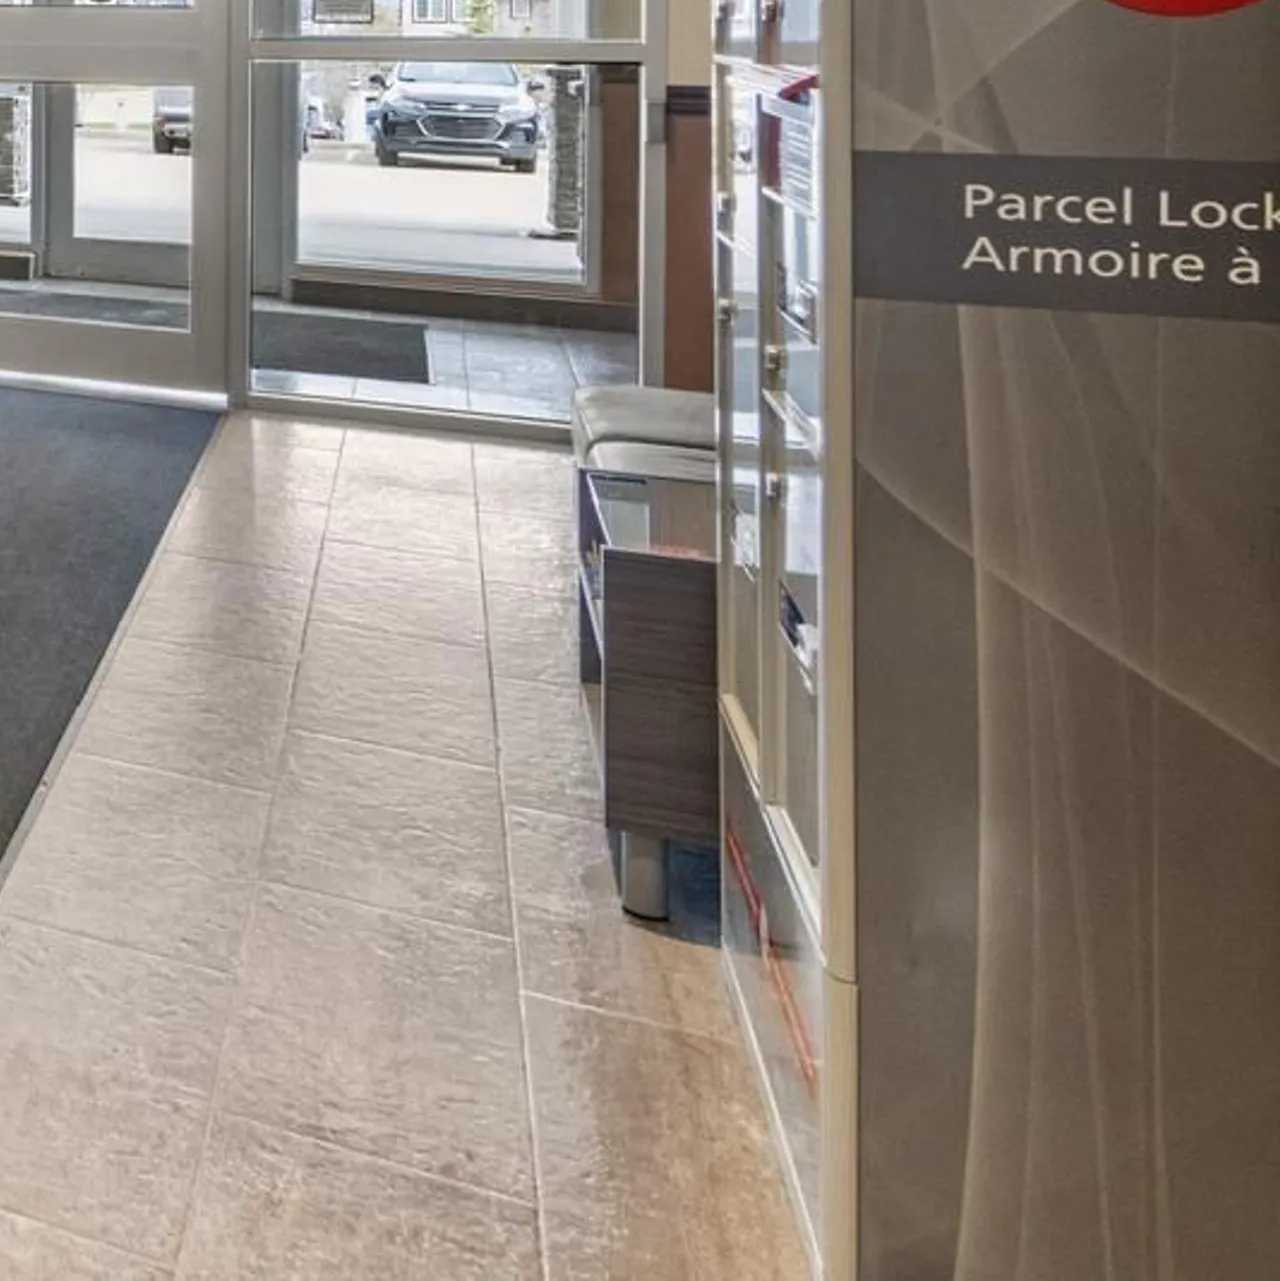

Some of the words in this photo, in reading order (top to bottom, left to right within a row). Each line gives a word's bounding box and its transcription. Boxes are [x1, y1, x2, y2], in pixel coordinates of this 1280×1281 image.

[964, 183, 1133, 226] Parcel
[962, 236, 1206, 282] Armoire
[1227, 246, 1262, 285] à
